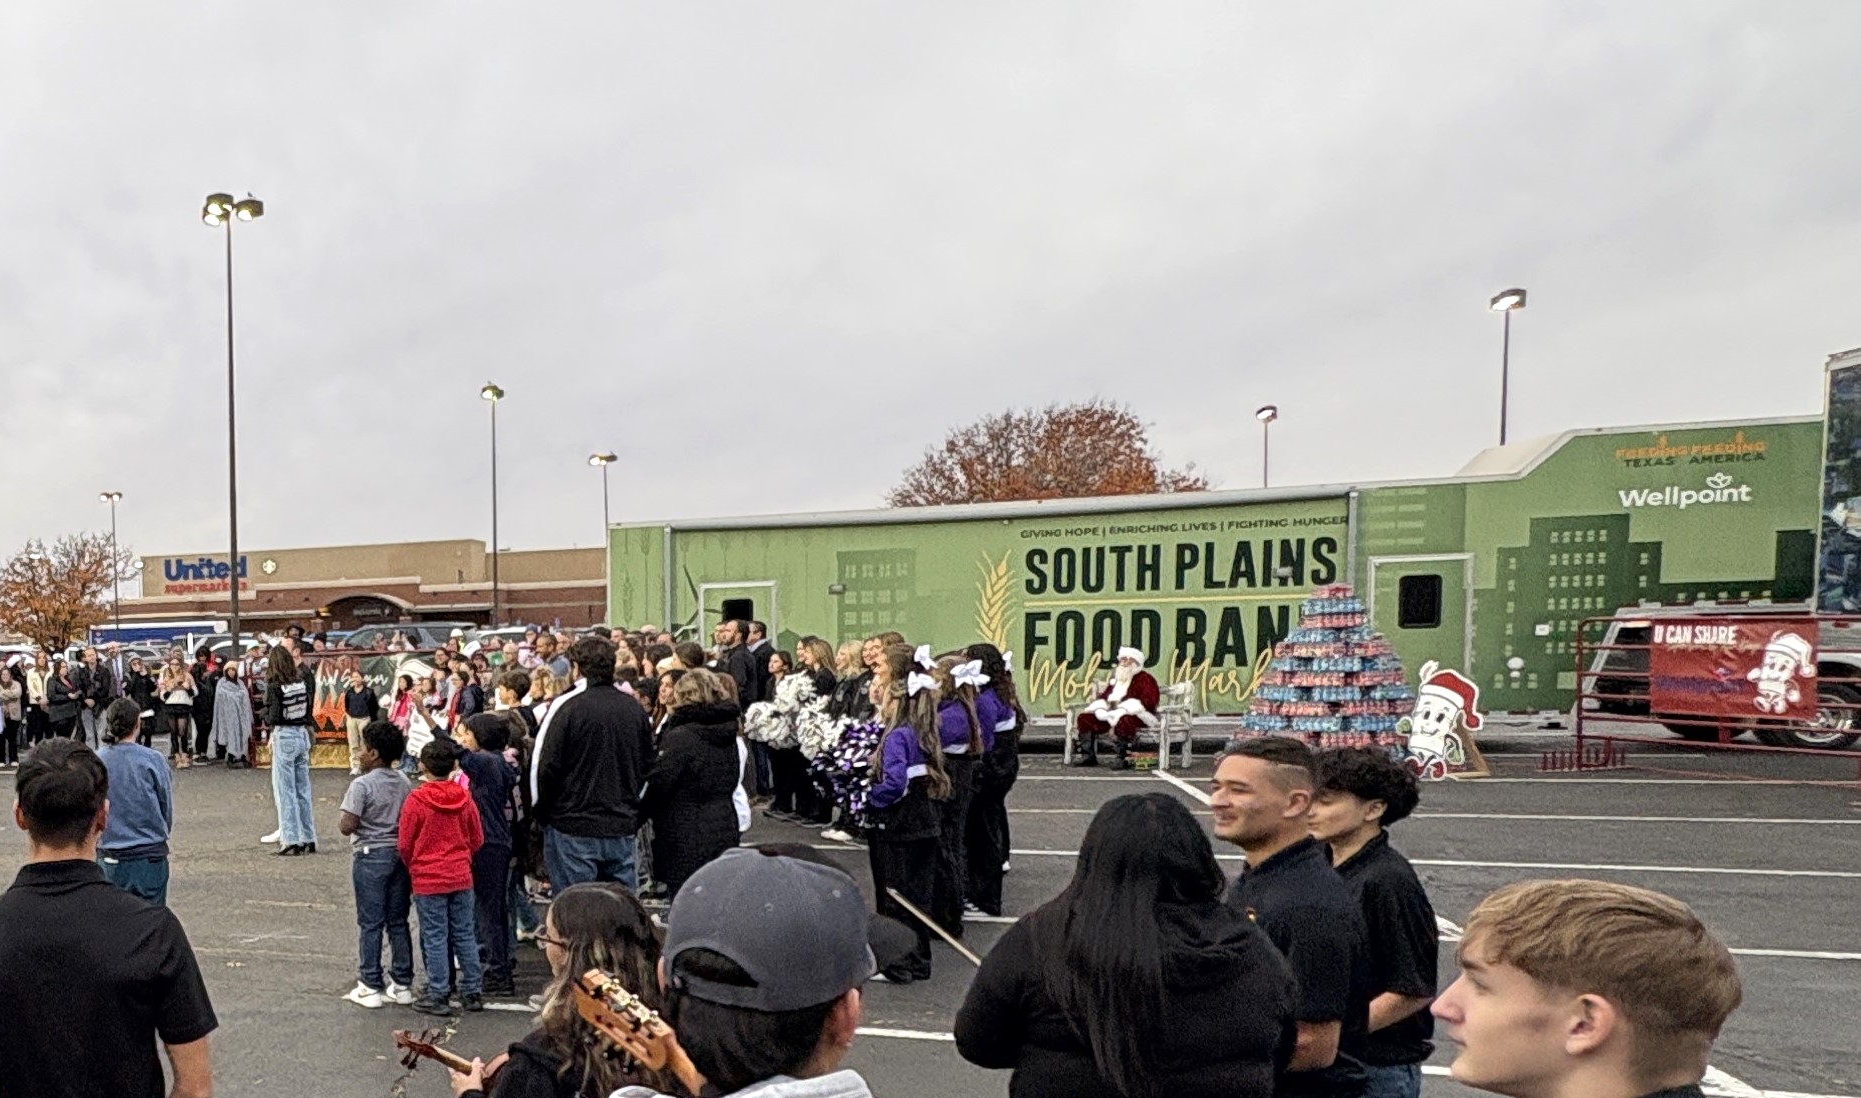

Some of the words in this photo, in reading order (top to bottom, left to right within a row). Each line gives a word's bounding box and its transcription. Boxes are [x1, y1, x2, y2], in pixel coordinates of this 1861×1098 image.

[1624, 456, 1675, 468] TEXAS
[1688, 452, 1766, 465] AMERICA
[1618, 484, 1753, 510] Wellpoint
[1020, 528, 1062, 539] GIVING
[1065, 526, 1100, 537] HOPE
[1109, 523, 1178, 535] ENRICHING
[1181, 521, 1217, 532] LIVES
[1227, 517, 1288, 530] FIGHTING
[1293, 515, 1348, 527] HUNGER
[164, 555, 247, 582] United
[1025, 543, 1161, 595] SOUTH
[1175, 536, 1337, 590] PLAINS
[164, 581, 247, 595] supermarks
[1024, 607, 1161, 671] FOOD
[1176, 605, 1291, 668] BAN
[1653, 625, 1665, 643] U
[1666, 625, 1692, 644] CAN
[1693, 625, 1738, 645] SHARE
